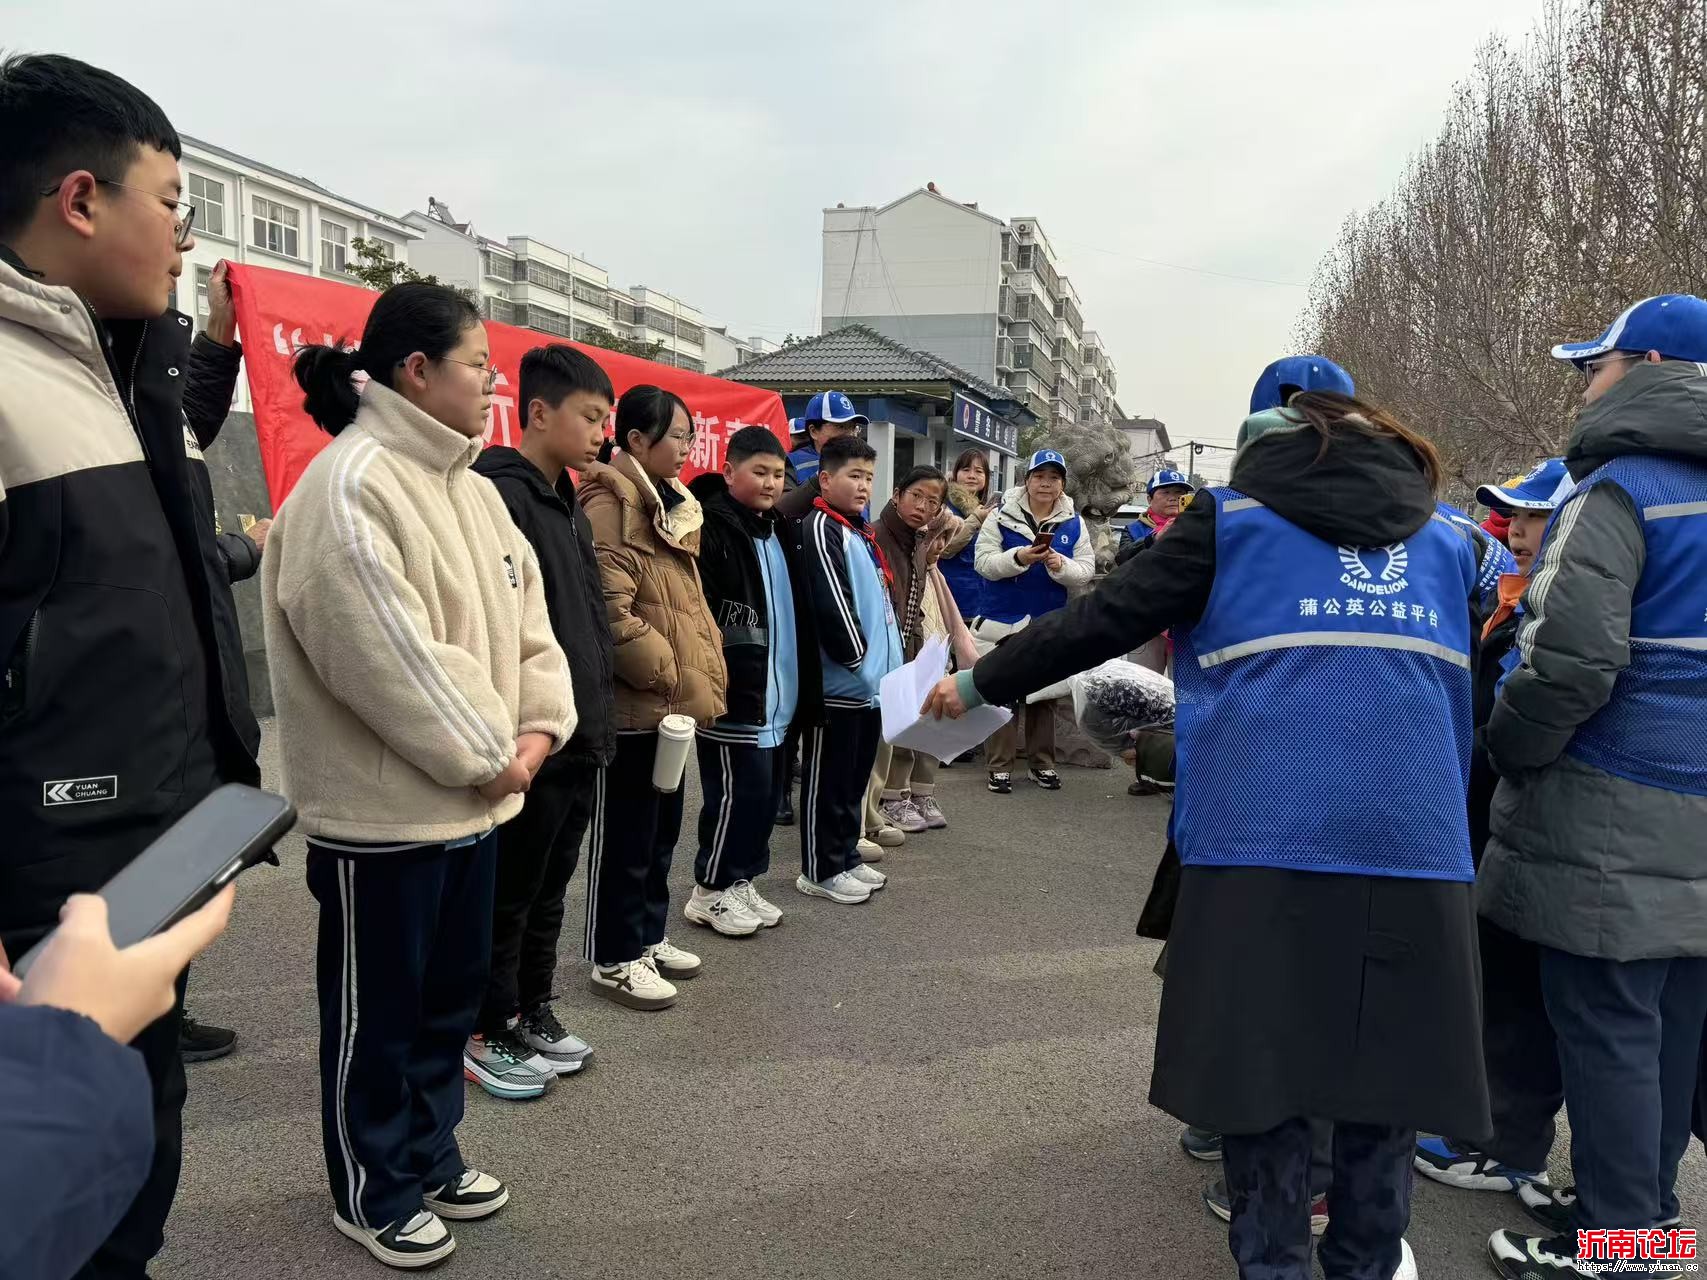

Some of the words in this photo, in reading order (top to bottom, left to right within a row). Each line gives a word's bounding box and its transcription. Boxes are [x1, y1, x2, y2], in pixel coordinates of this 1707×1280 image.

[1339, 572, 1409, 595] DANDELION
[1299, 598, 1438, 628] 蒲公英公益平台
[75, 789, 108, 798] CHUANG
